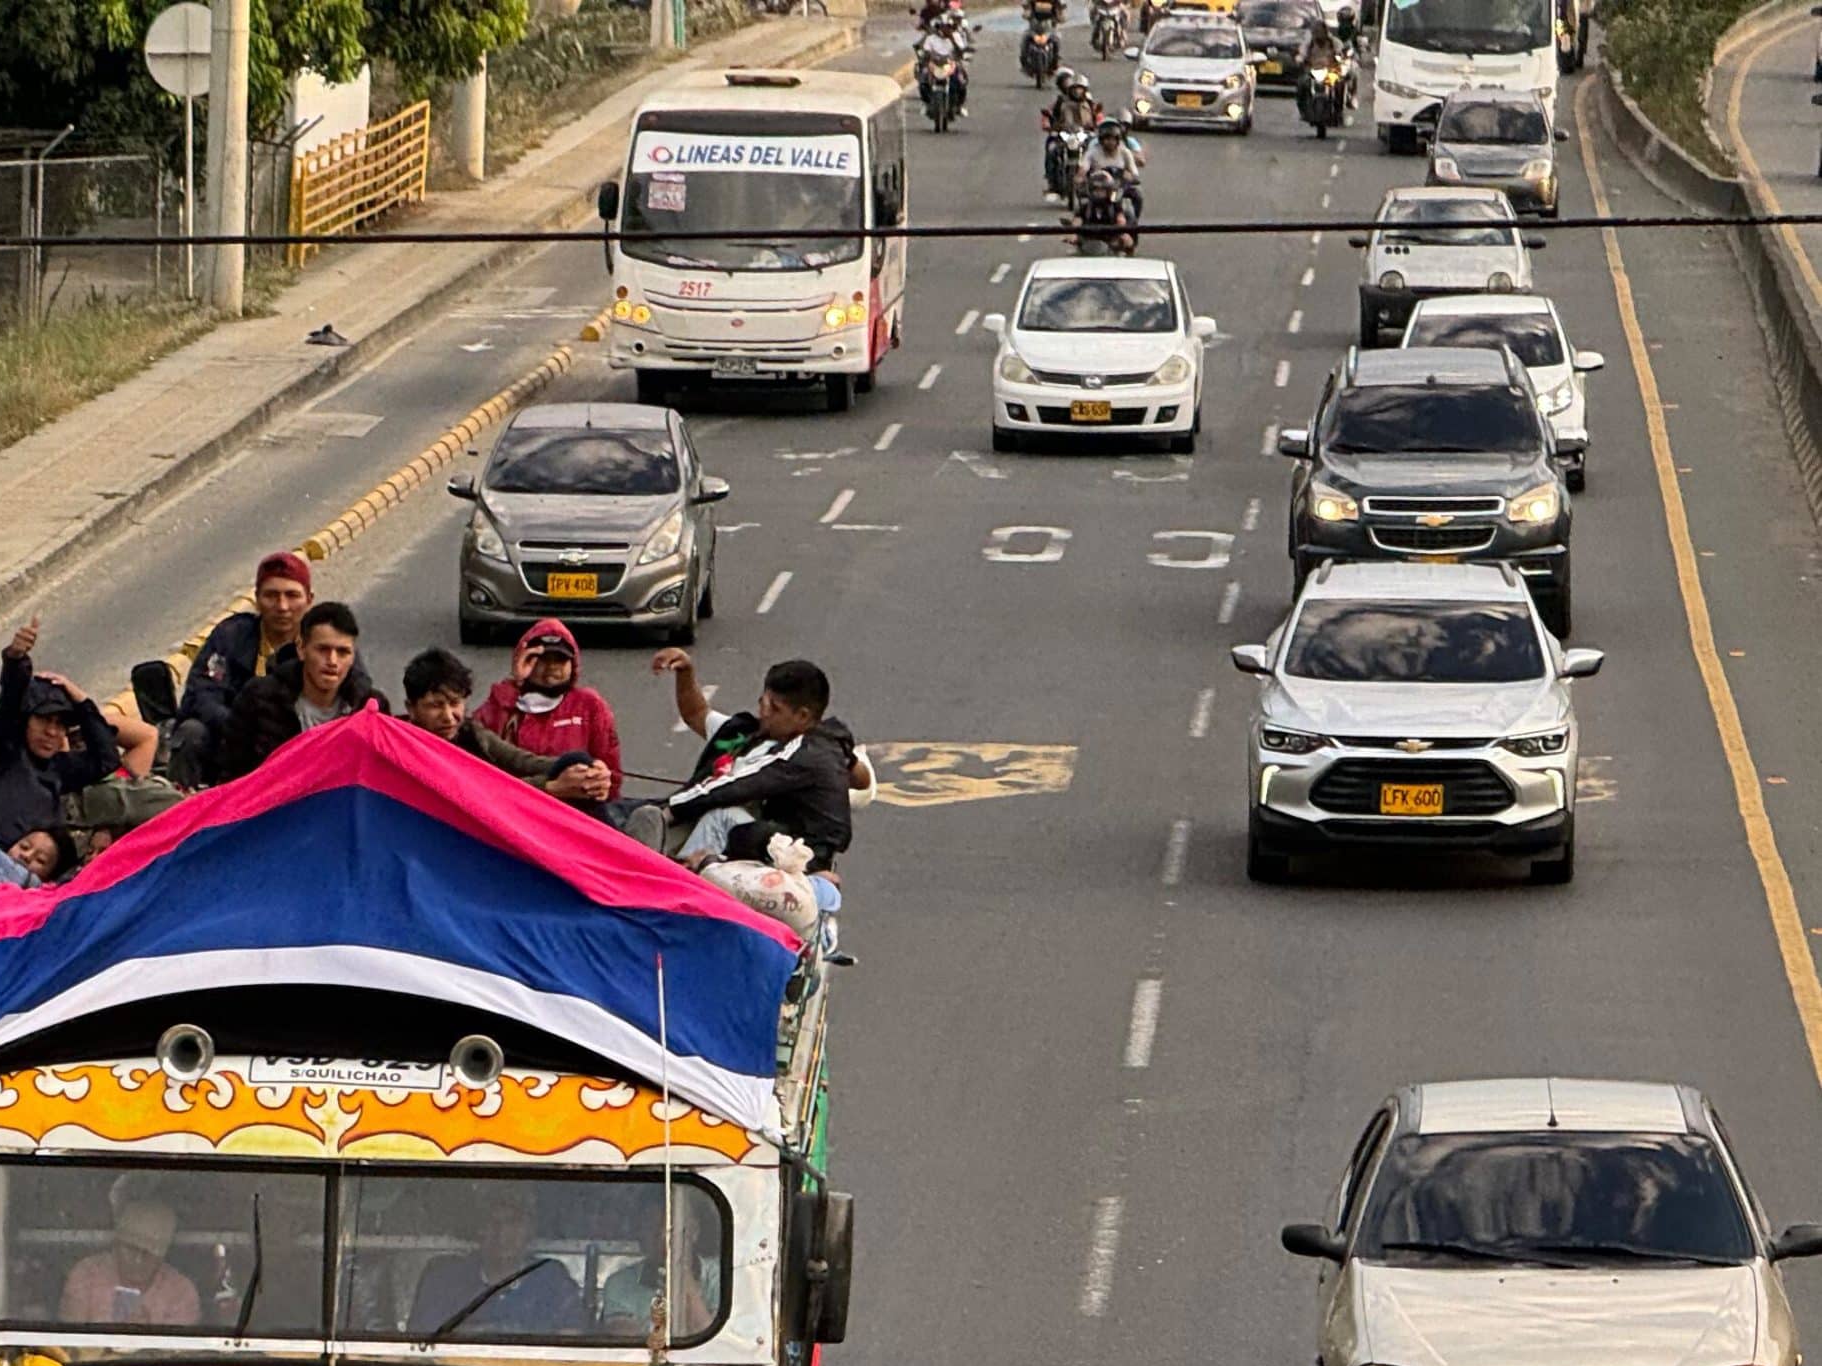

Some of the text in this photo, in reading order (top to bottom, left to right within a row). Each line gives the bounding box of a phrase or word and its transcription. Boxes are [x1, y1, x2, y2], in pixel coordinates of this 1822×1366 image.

[677, 145, 849, 170] LINEAS DEL VALLE
[678, 280, 713, 297] 2517
[1384, 789, 1441, 806] LFK 600
[290, 1068, 402, 1082] S/QUILICHAO
